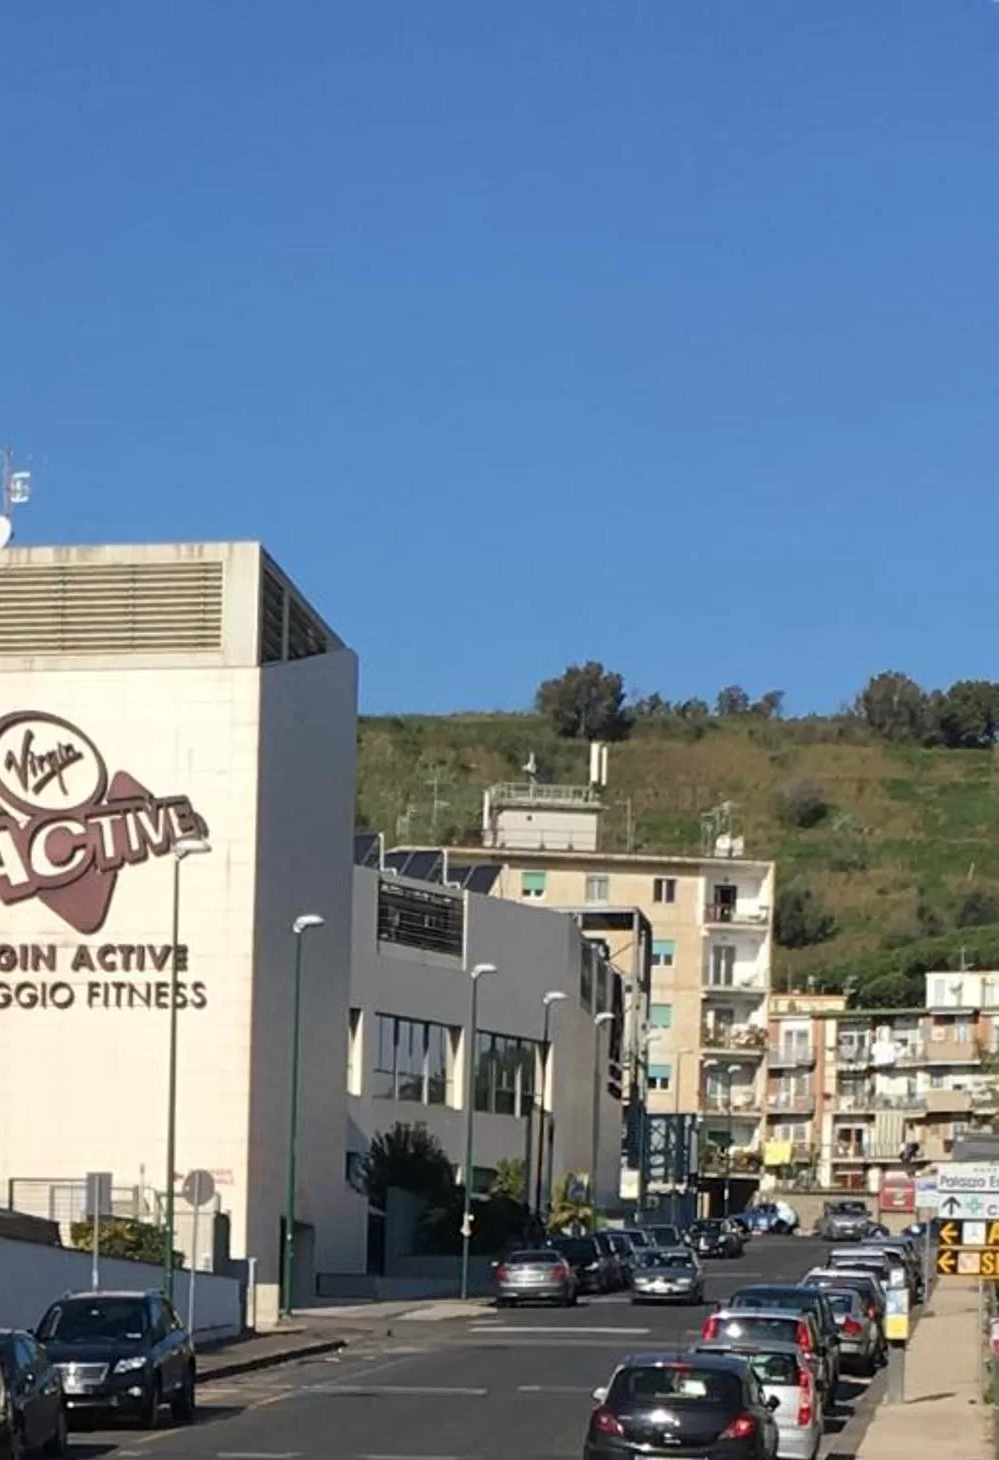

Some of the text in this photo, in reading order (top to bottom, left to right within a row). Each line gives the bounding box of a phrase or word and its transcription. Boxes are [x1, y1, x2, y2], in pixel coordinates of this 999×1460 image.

[4, 728, 84, 797] Virgin
[70, 944, 189, 974] ACTIVE
[87, 981, 208, 1010] FITNESS
[940, 1175, 986, 1188] Palazzo
